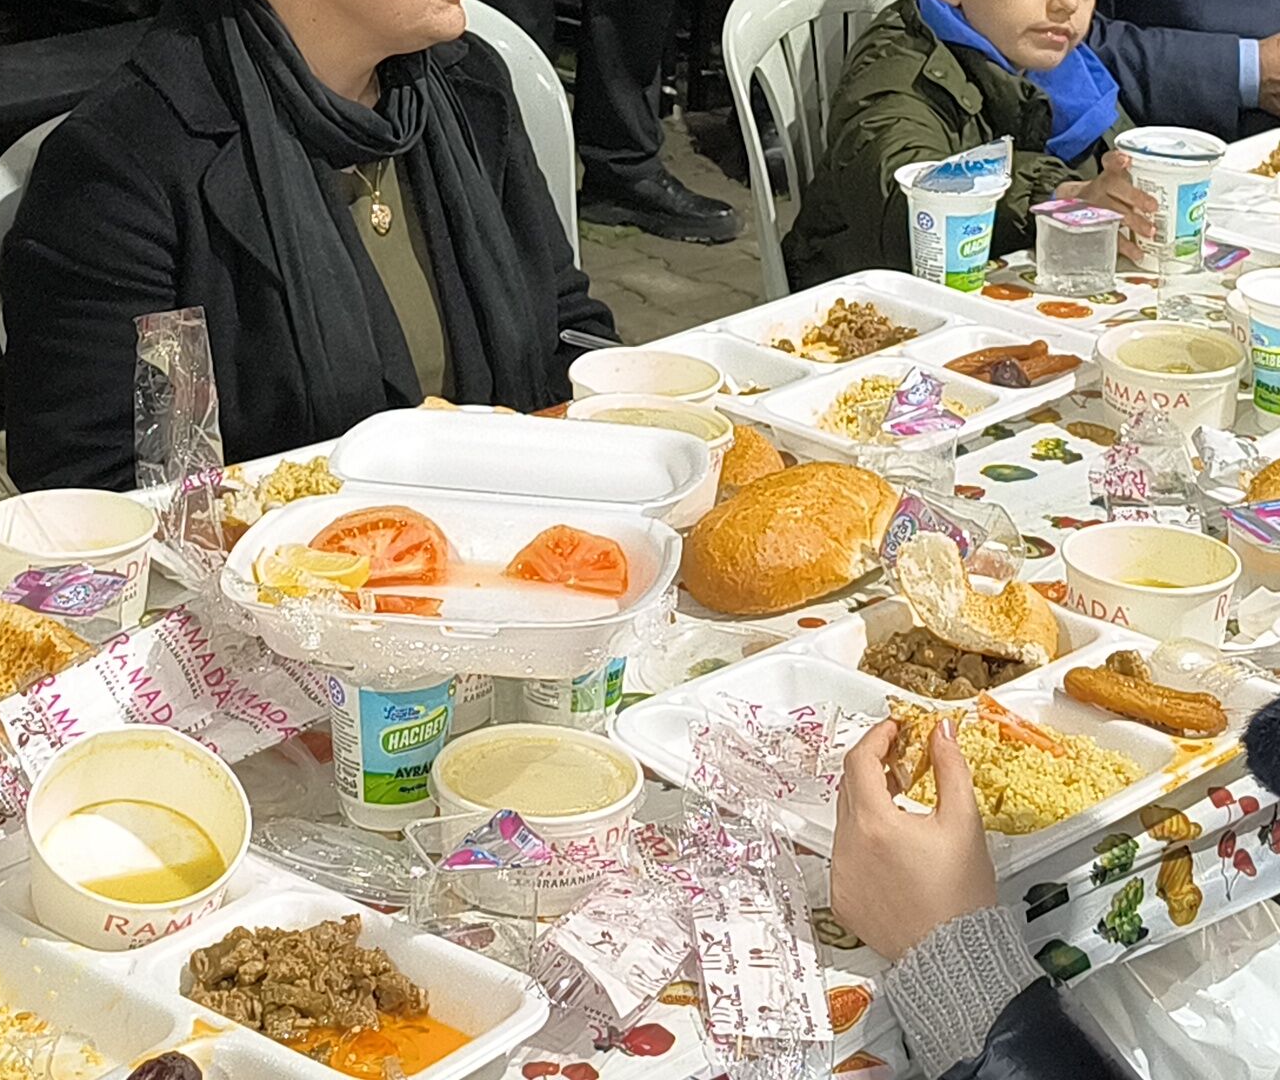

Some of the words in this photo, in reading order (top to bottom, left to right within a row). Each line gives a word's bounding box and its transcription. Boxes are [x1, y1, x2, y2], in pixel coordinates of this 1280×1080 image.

[1104, 375, 1190, 409] AMADA
[106, 631, 174, 725] RAMAD
[103, 899, 215, 937] RAMA
